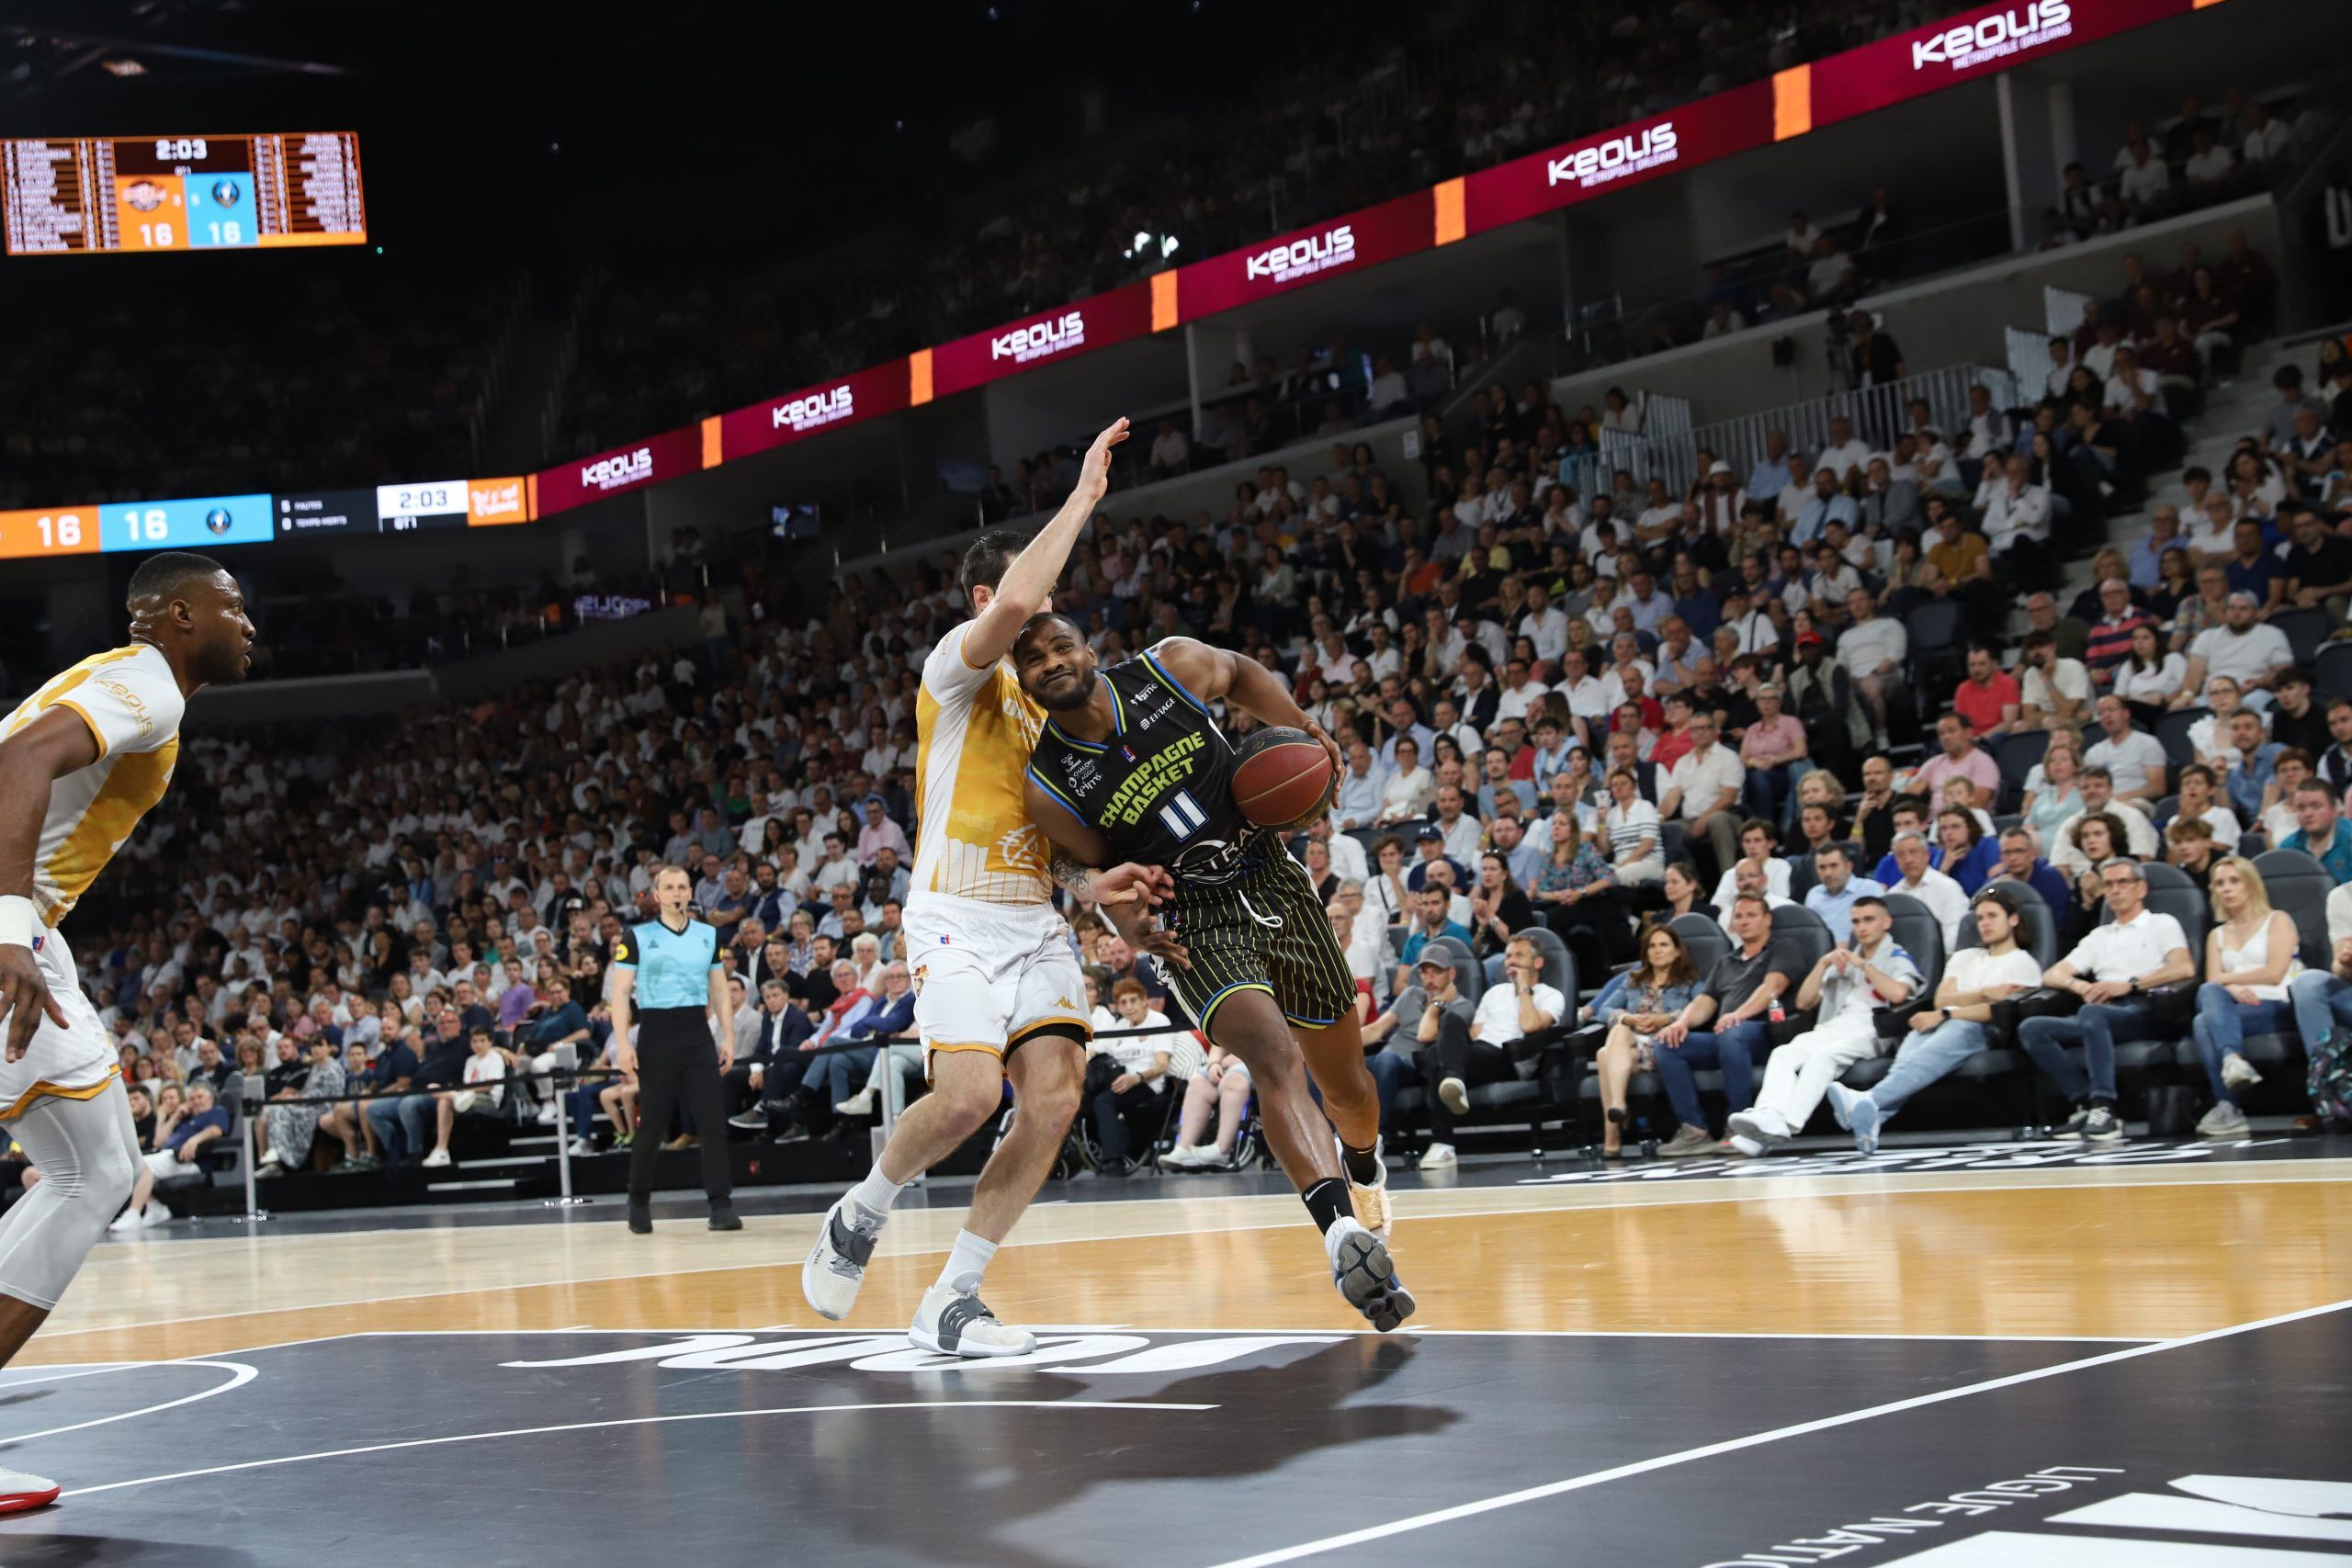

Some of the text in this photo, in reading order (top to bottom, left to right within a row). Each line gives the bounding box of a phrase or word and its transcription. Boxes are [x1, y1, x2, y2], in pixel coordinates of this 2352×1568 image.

[155, 139, 208, 161] 2:03
[140, 222, 174, 247] 16
[209, 220, 242, 244] 16
[400, 489, 448, 509] 2:03
[37, 514, 82, 547] 16
[124, 509, 168, 542] 16
[1099, 731, 1205, 829] CHAMPAGNE
[1122, 756, 1194, 826] BASKET
[1158, 787, 1210, 842] 11
[1905, 1466, 2126, 1517] LIGUE
